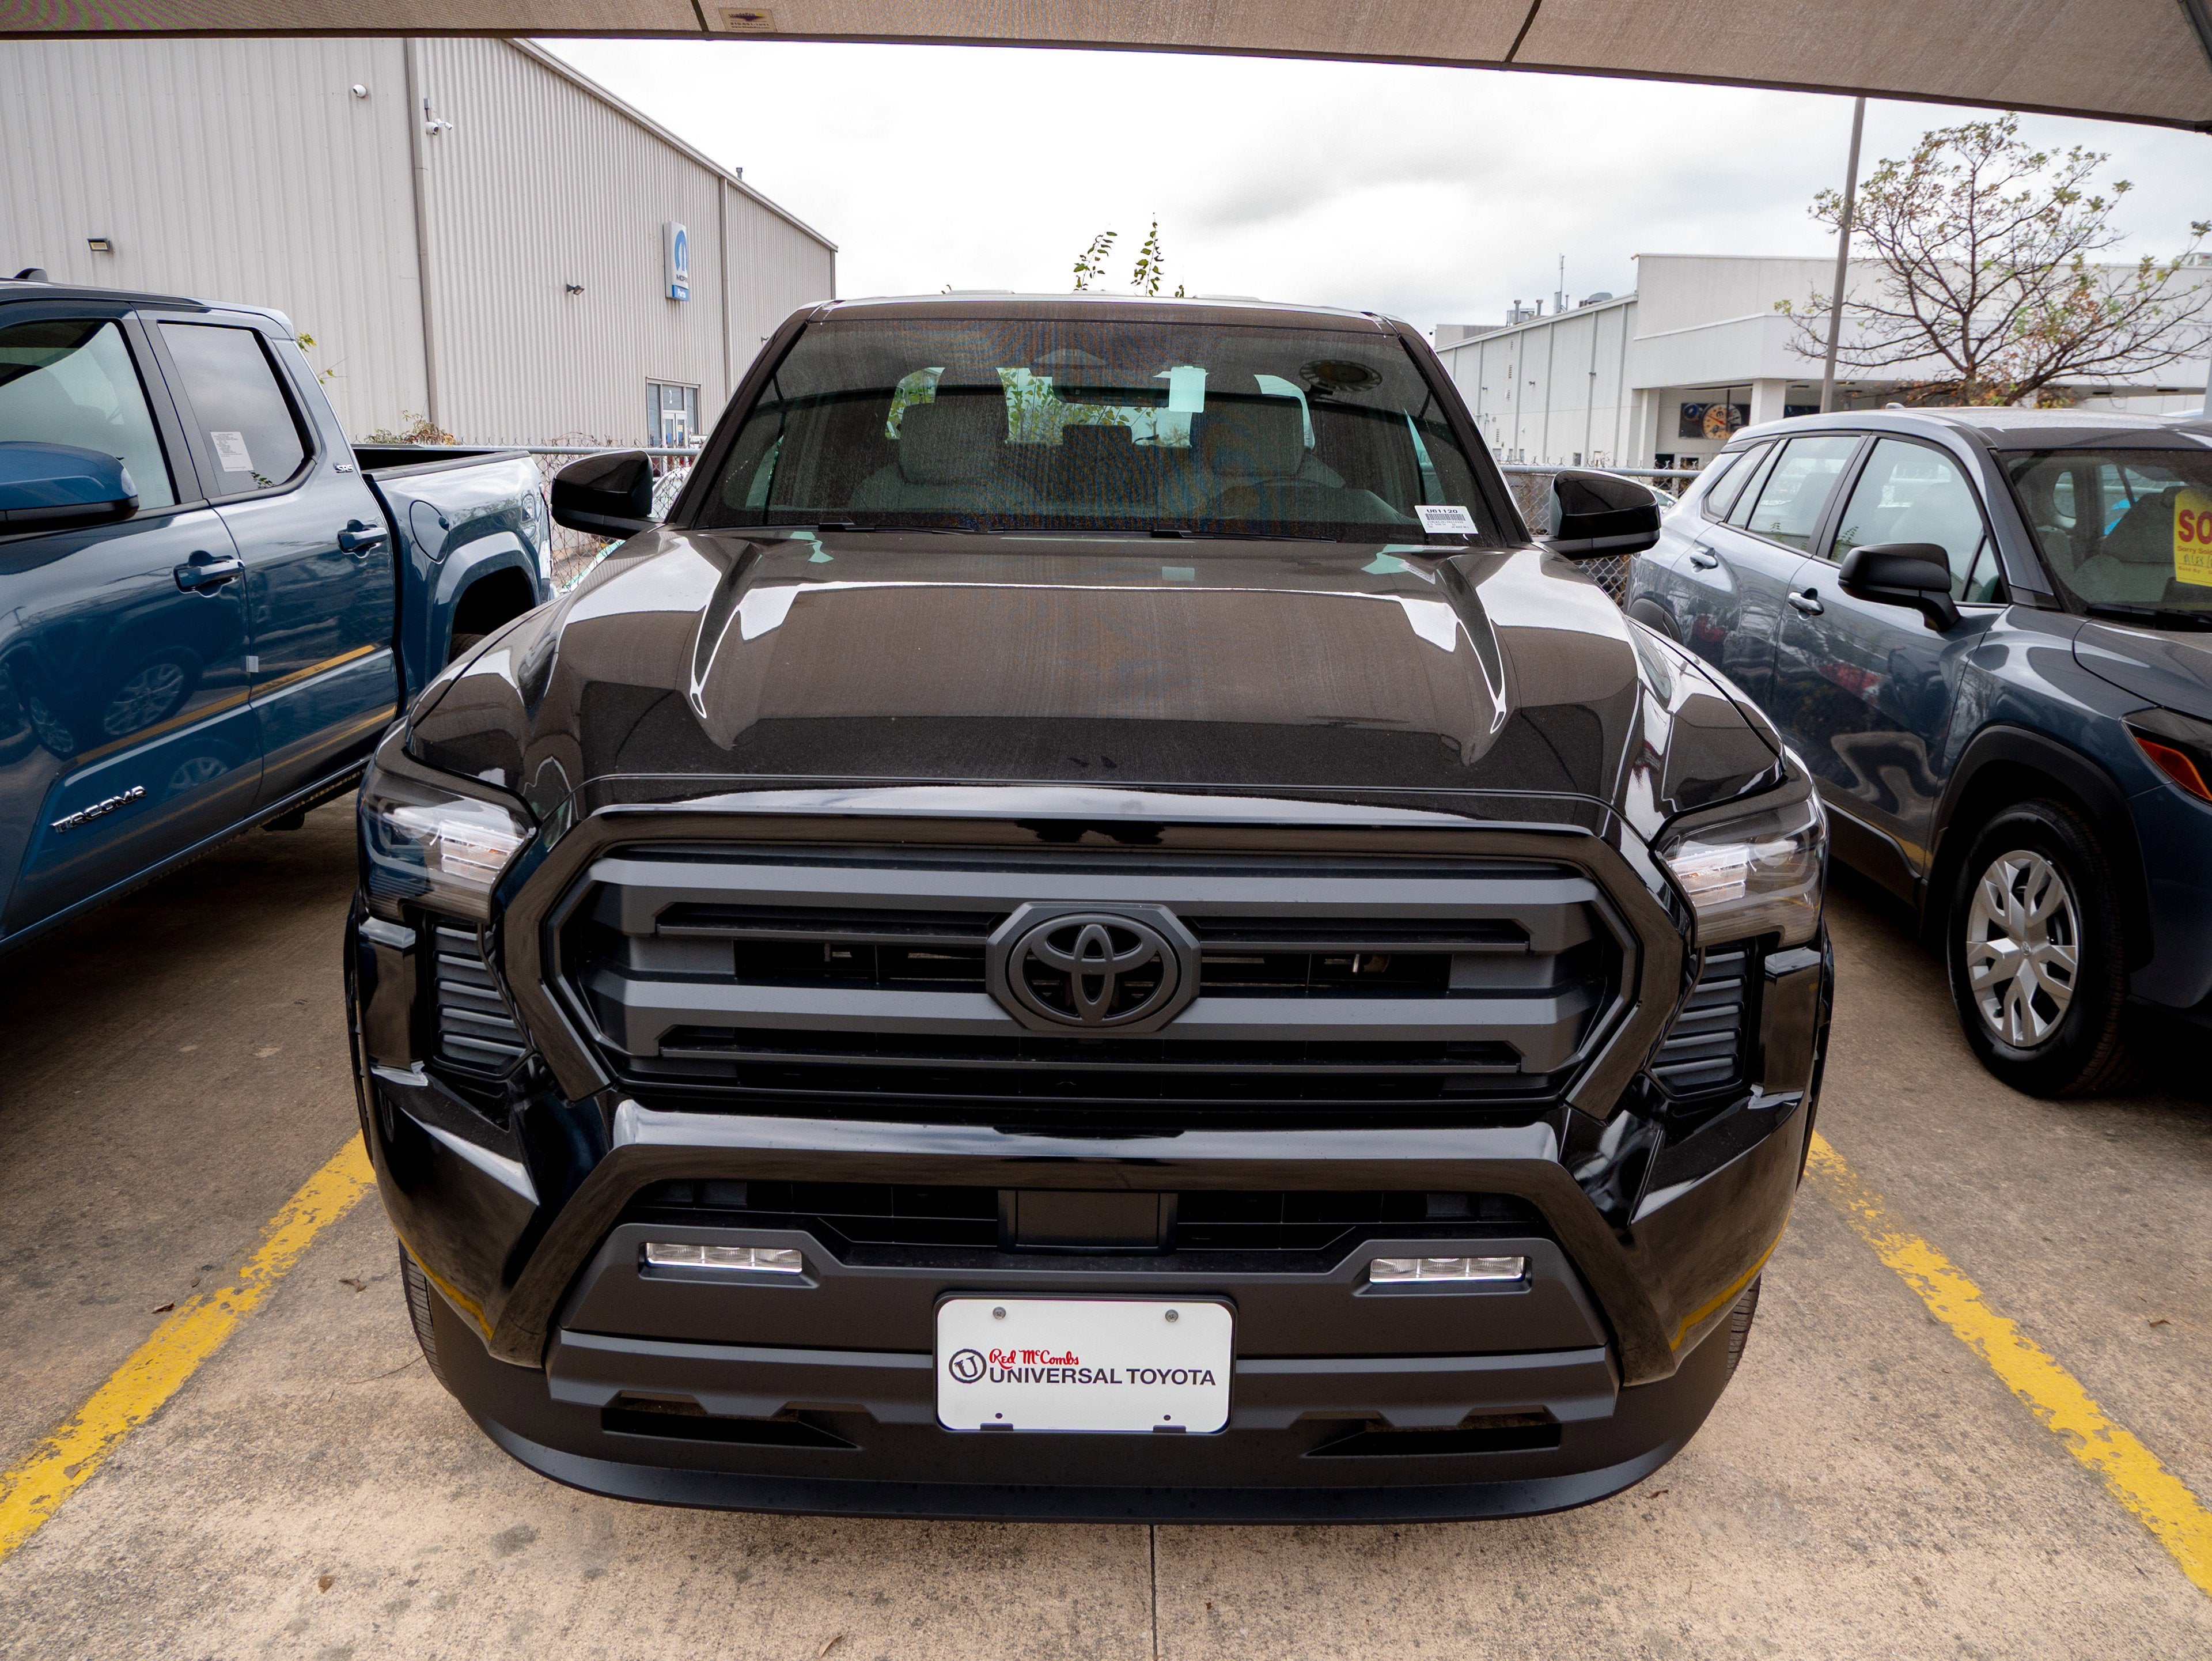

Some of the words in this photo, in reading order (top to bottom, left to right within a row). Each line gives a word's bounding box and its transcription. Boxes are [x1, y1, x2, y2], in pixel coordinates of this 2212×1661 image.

[677, 288, 686, 298] Parts
[2177, 546, 2196, 554] Sorry
[48, 785, 147, 834] TACOMA
[989, 1348, 1016, 1369] Red
[1018, 1349, 1080, 1365] McCombs
[989, 1367, 1123, 1384] UNIVERSAL
[1126, 1368, 1217, 1386] TOYOTA
